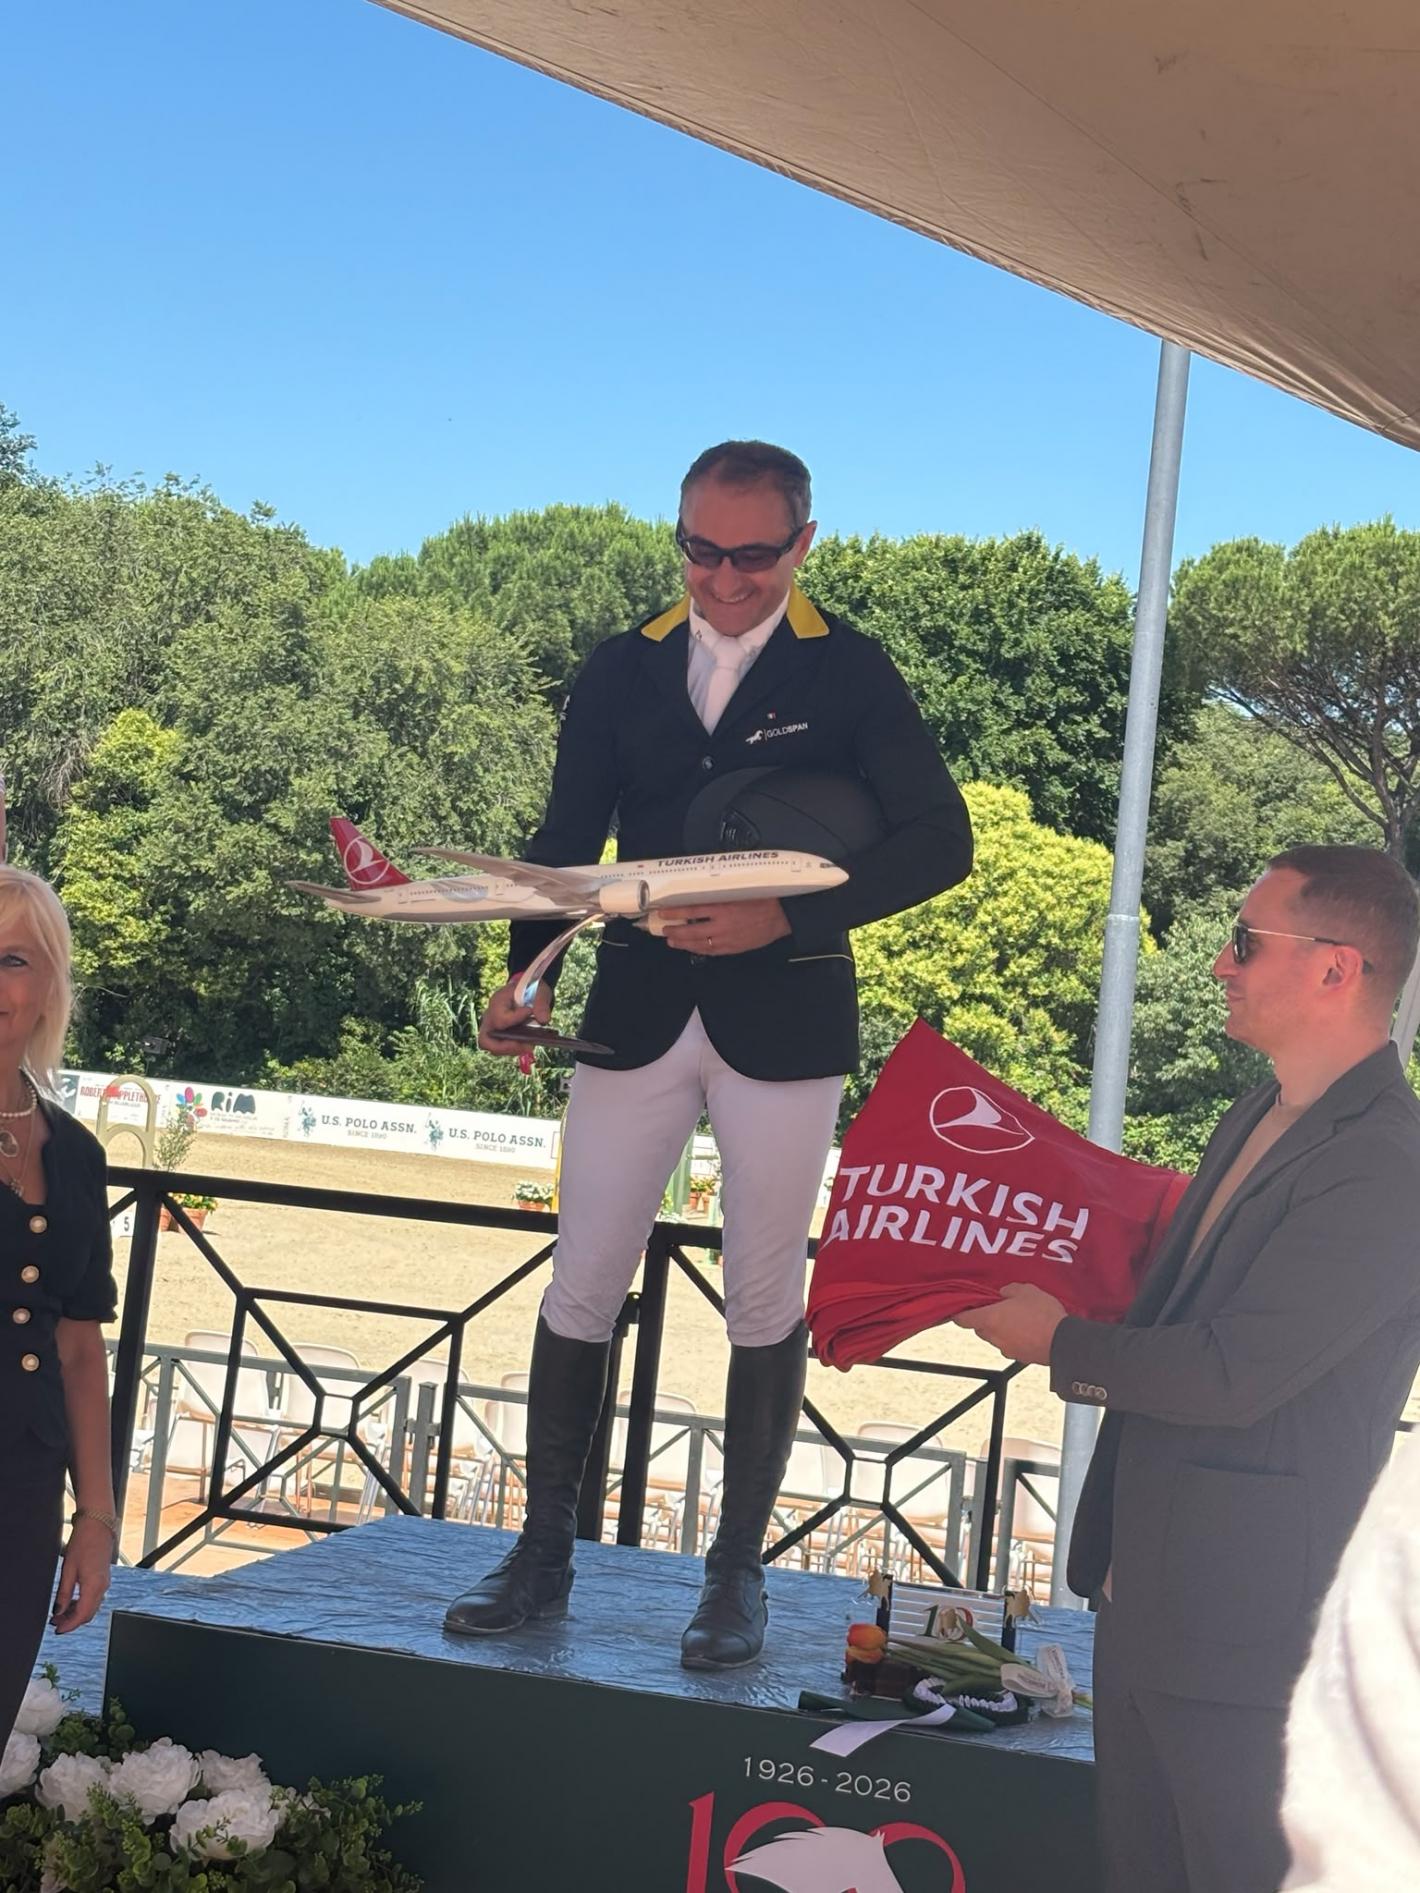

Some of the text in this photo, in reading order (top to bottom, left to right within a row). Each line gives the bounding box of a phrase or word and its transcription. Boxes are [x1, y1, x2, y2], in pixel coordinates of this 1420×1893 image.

[767, 722, 809, 739] GOLDSPAN
[658, 851, 779, 868] TURKISH AIRLINES
[321, 1115, 417, 1134] U.S. POLO ASSN.
[448, 1127, 546, 1149] U.S. POLO ASSN.
[839, 1162, 1090, 1241] TURKISH
[124, 1216, 130, 1232] 5
[820, 1204, 1079, 1264] AIRLINES
